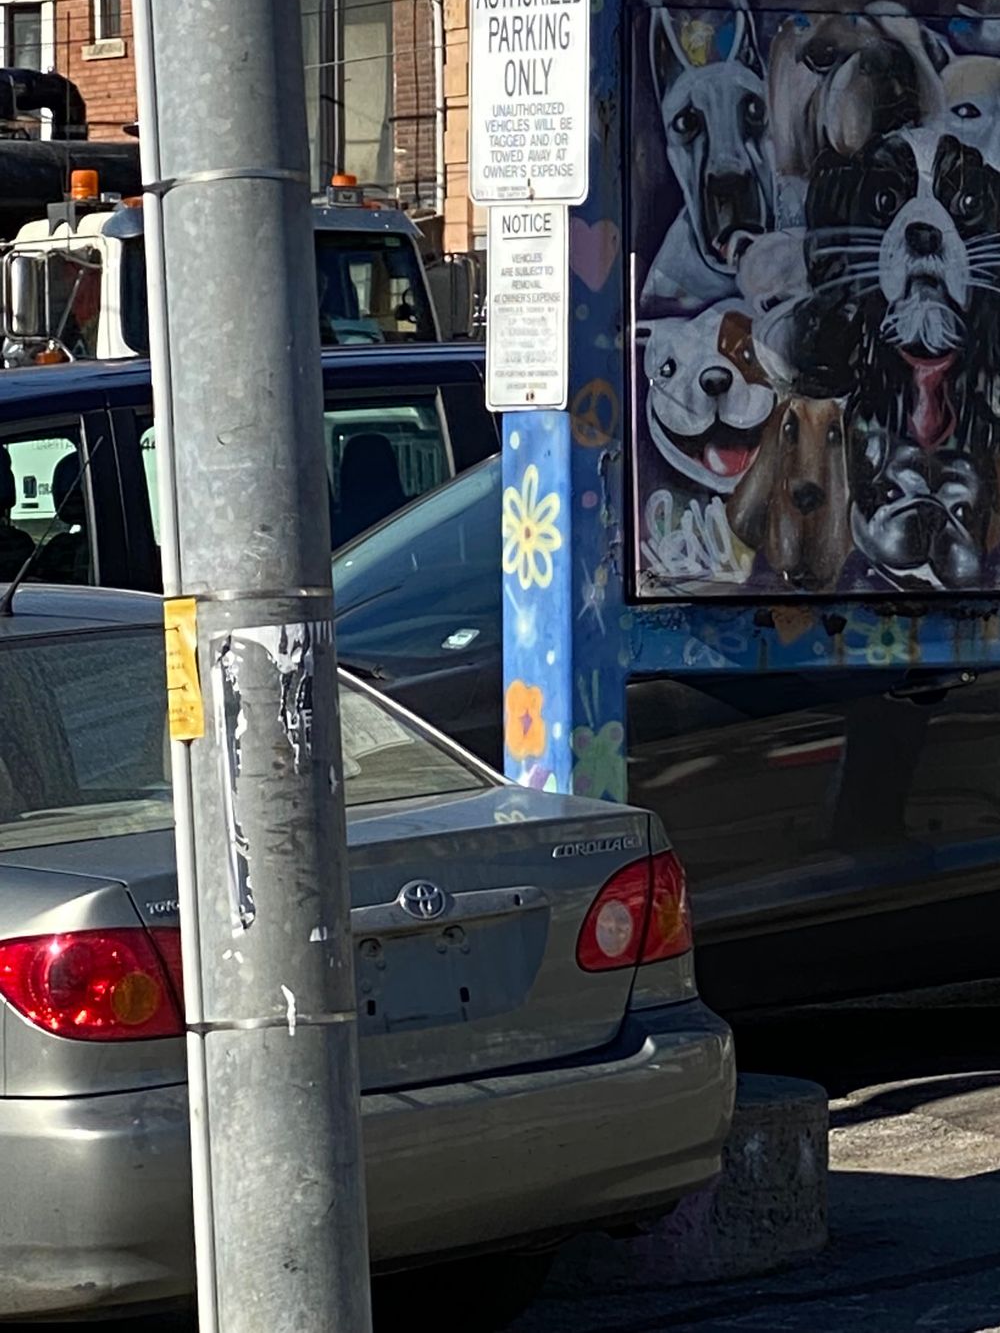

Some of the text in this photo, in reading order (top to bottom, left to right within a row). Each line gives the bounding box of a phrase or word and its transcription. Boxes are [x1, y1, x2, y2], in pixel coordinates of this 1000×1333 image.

[488, 12, 571, 54] PARKING
[504, 57, 553, 97] ONLY
[492, 102, 565, 118] UNAUTHORIZED
[484, 117, 573, 133] VEHICLES WILL BE
[489, 134, 526, 148] TAGGED
[490, 148, 568, 164] TOWED AWAY AT
[483, 163, 574, 179] OWNER'S EXPENSE
[502, 212, 552, 234] NOTICE
[552, 839, 622, 859] COROLLA
